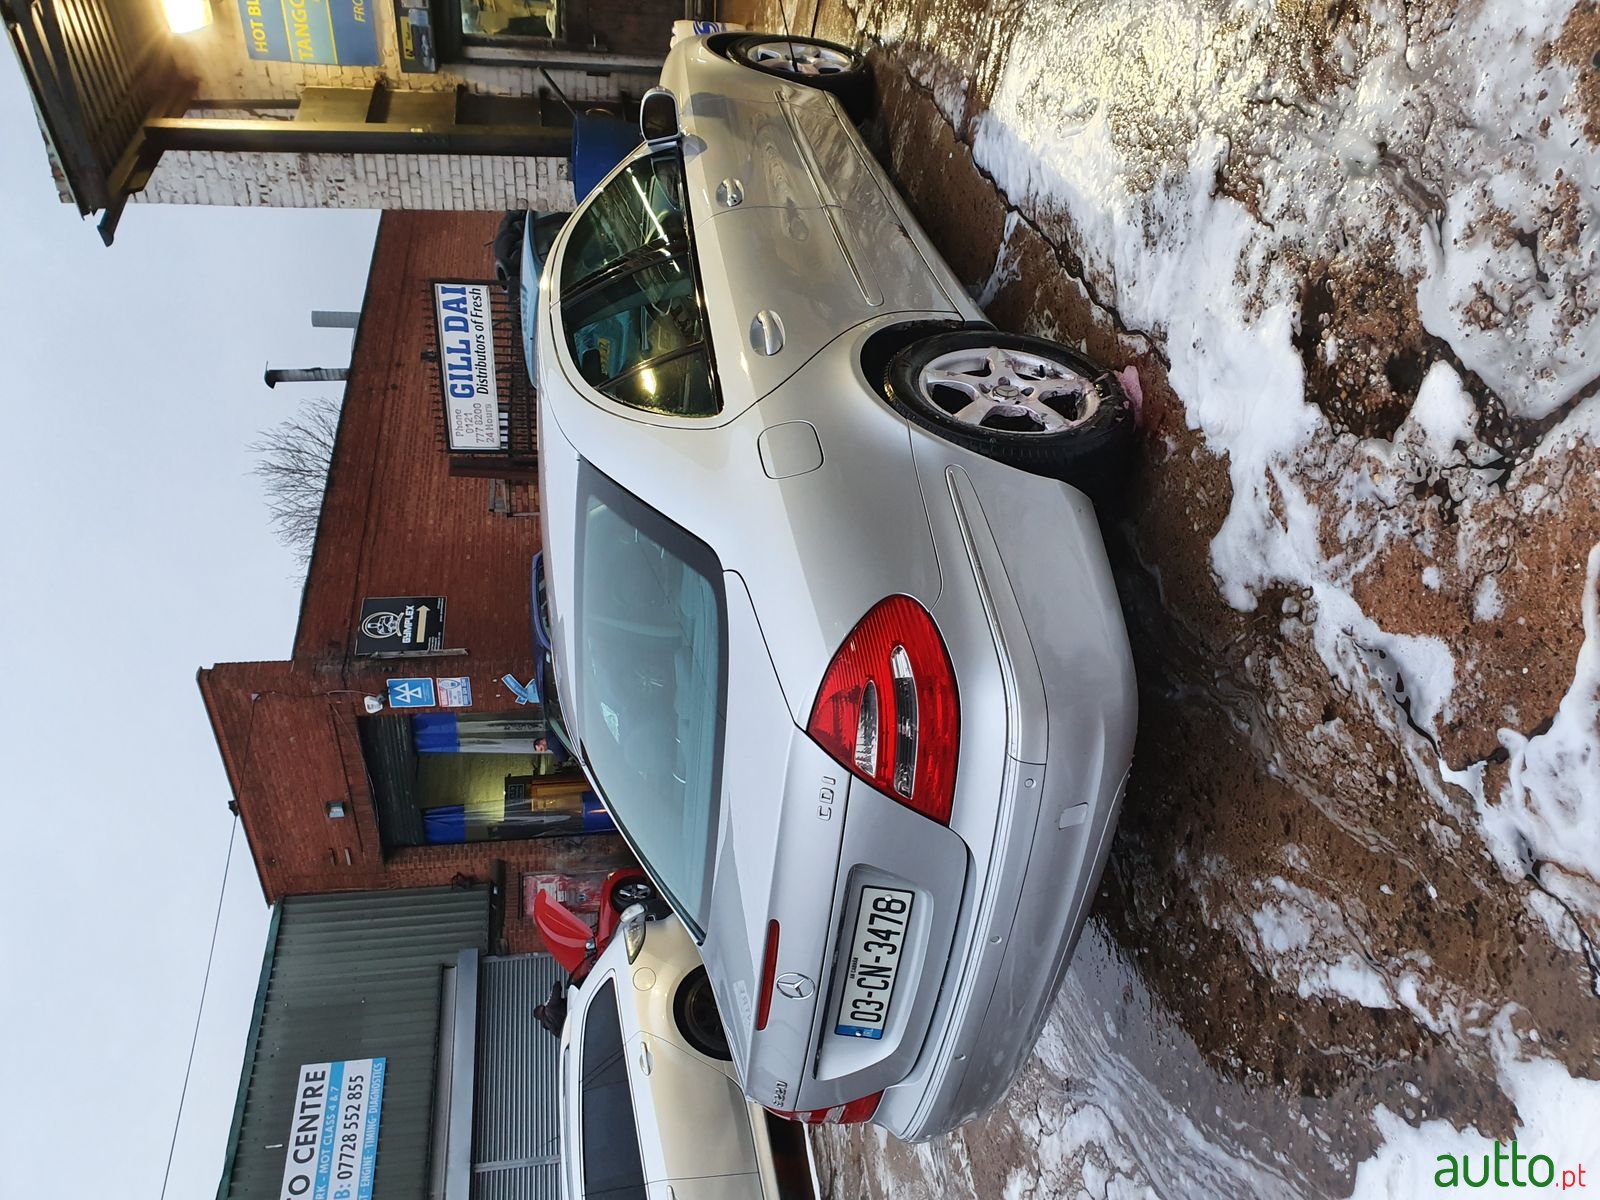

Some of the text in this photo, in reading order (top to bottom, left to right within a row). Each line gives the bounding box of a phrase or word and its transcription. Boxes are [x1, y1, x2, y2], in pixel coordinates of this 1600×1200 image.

[250, 20, 268, 52] HOT
[441, 286, 475, 399] GILL DAI
[468, 288, 489, 395] Distributors of Fresh
[455, 409, 464, 437] Phone
[464, 412, 475, 434] 0121
[473, 403, 485, 443] 777 8200
[484, 403, 495, 443] 24 Hours
[402, 605, 415, 644] GYMPLEX
[817, 775, 837, 821] CDI
[850, 896, 907, 1022] 03-CN-3478
[347, 1075, 364, 1100] 855
[293, 1070, 326, 1164] CENTRE
[324, 1114, 336, 1145] CLASS
[343, 1103, 361, 1130] 552
[361, 1154, 373, 1187] ENGINE
[369, 1062, 383, 1114] DIAGNOSTICS
[319, 1148, 330, 1174] MOT
[337, 1133, 357, 1180] 07728
